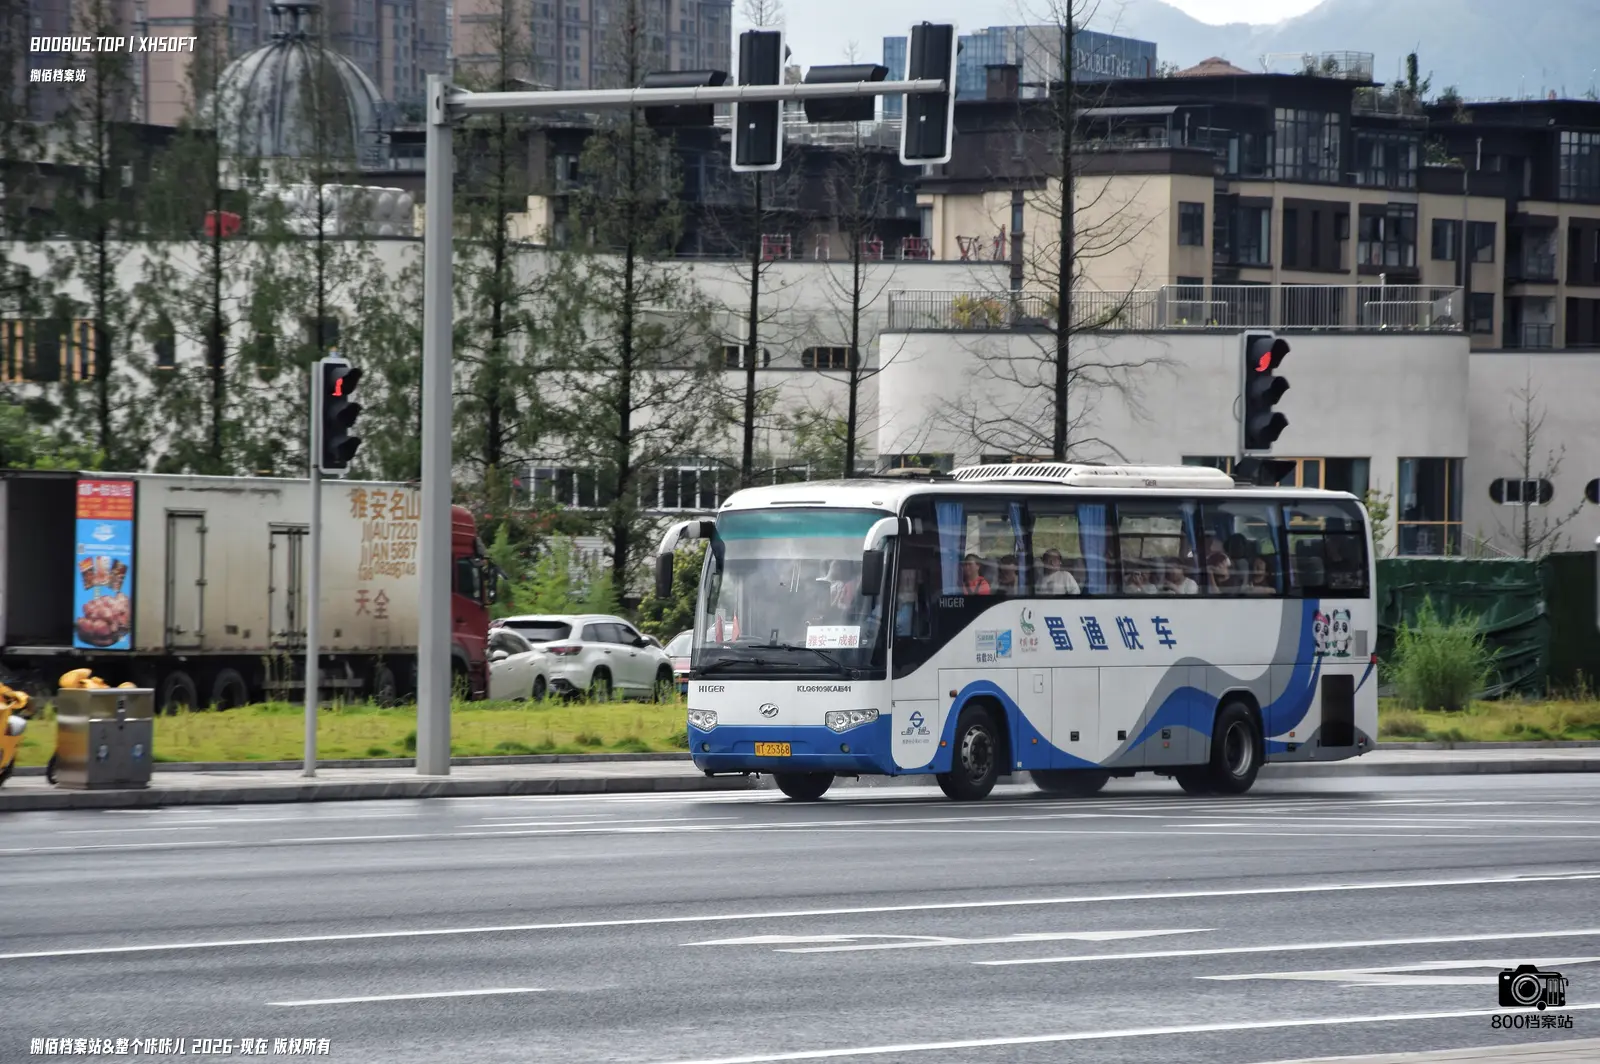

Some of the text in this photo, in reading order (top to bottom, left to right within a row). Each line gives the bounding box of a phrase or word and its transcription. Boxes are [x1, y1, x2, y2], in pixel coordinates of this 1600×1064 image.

[349, 487, 421, 521] 雅安名山
[355, 589, 389, 619] 天全
[939, 597, 965, 608] HIGER
[1044, 616, 1177, 651] 蜀通快车
